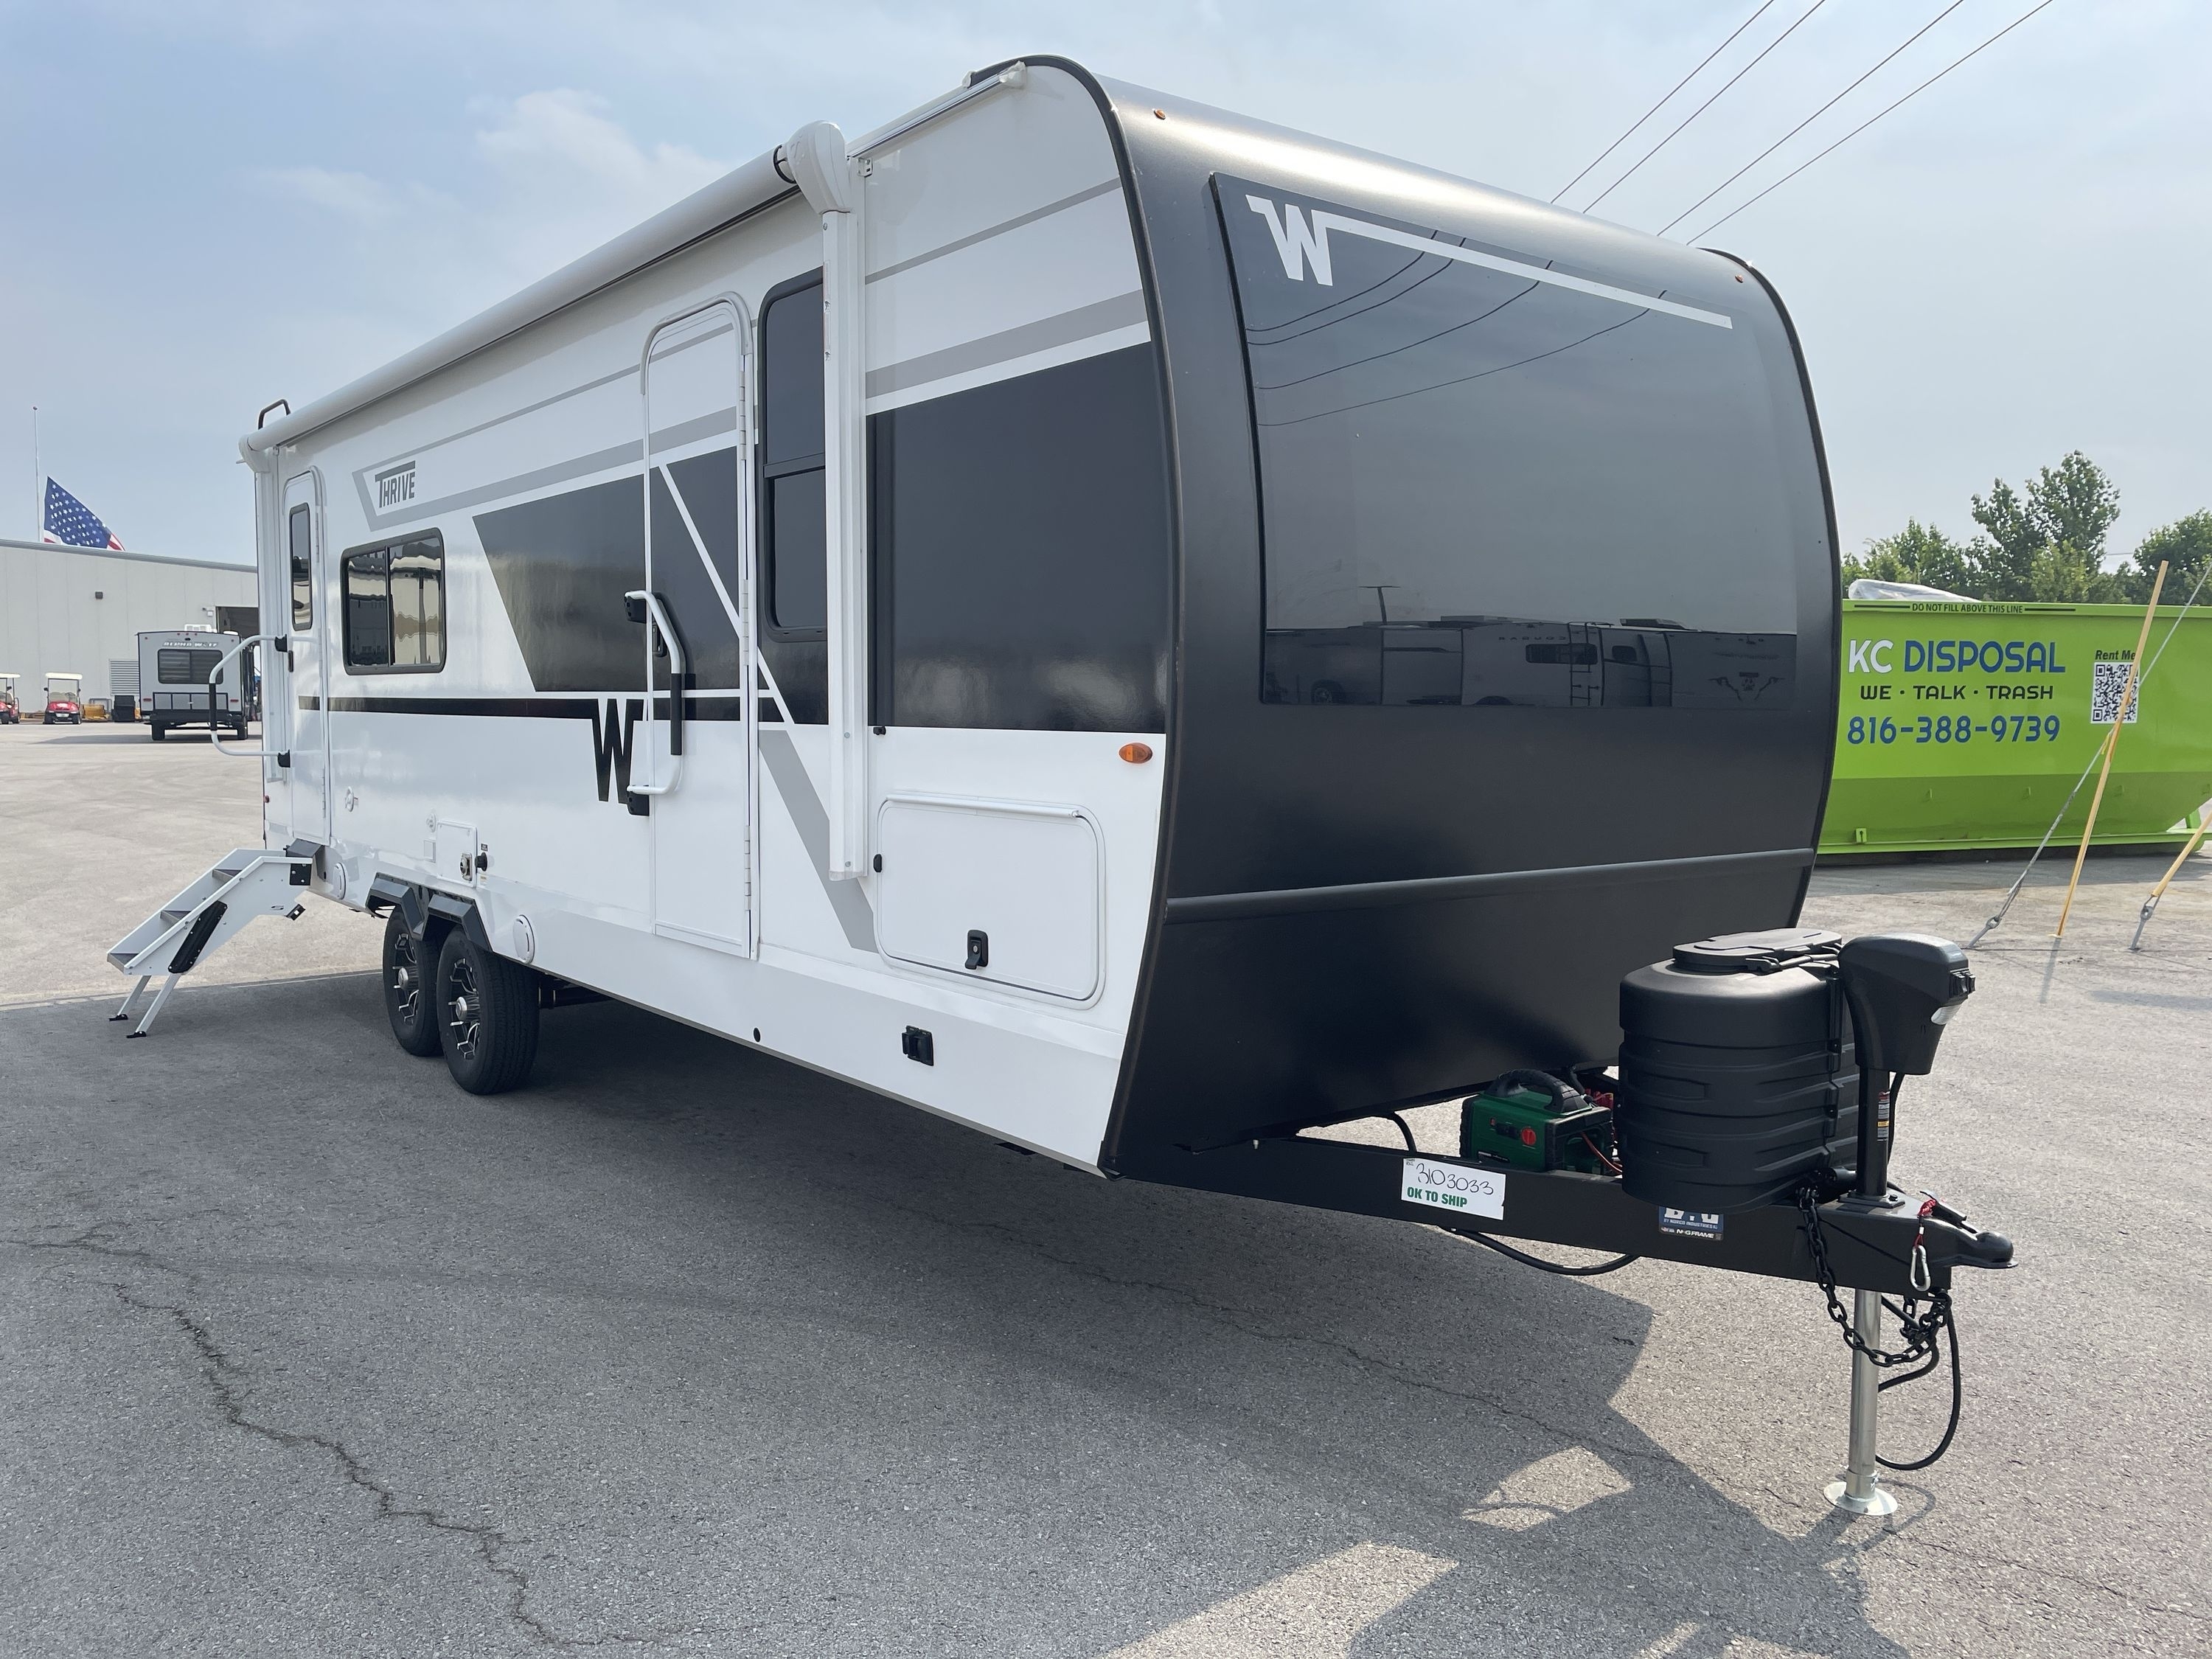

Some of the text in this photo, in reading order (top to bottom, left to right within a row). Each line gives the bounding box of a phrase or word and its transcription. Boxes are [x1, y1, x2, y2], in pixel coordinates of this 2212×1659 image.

[375, 460, 415, 507] THRIVE
[1912, 603, 1924, 611] DO
[1961, 605, 1986, 613] ABOVE
[1848, 639, 2065, 673] KC DISPOSAL
[2095, 650, 2136, 661] Rent Me
[1860, 685, 2053, 700] WE TALK TRASH
[1847, 715, 2060, 744] 816-388-9739
[1416, 1163, 1494, 1194] 3103033
[1407, 1186, 1467, 1208] OK TO SHIP
